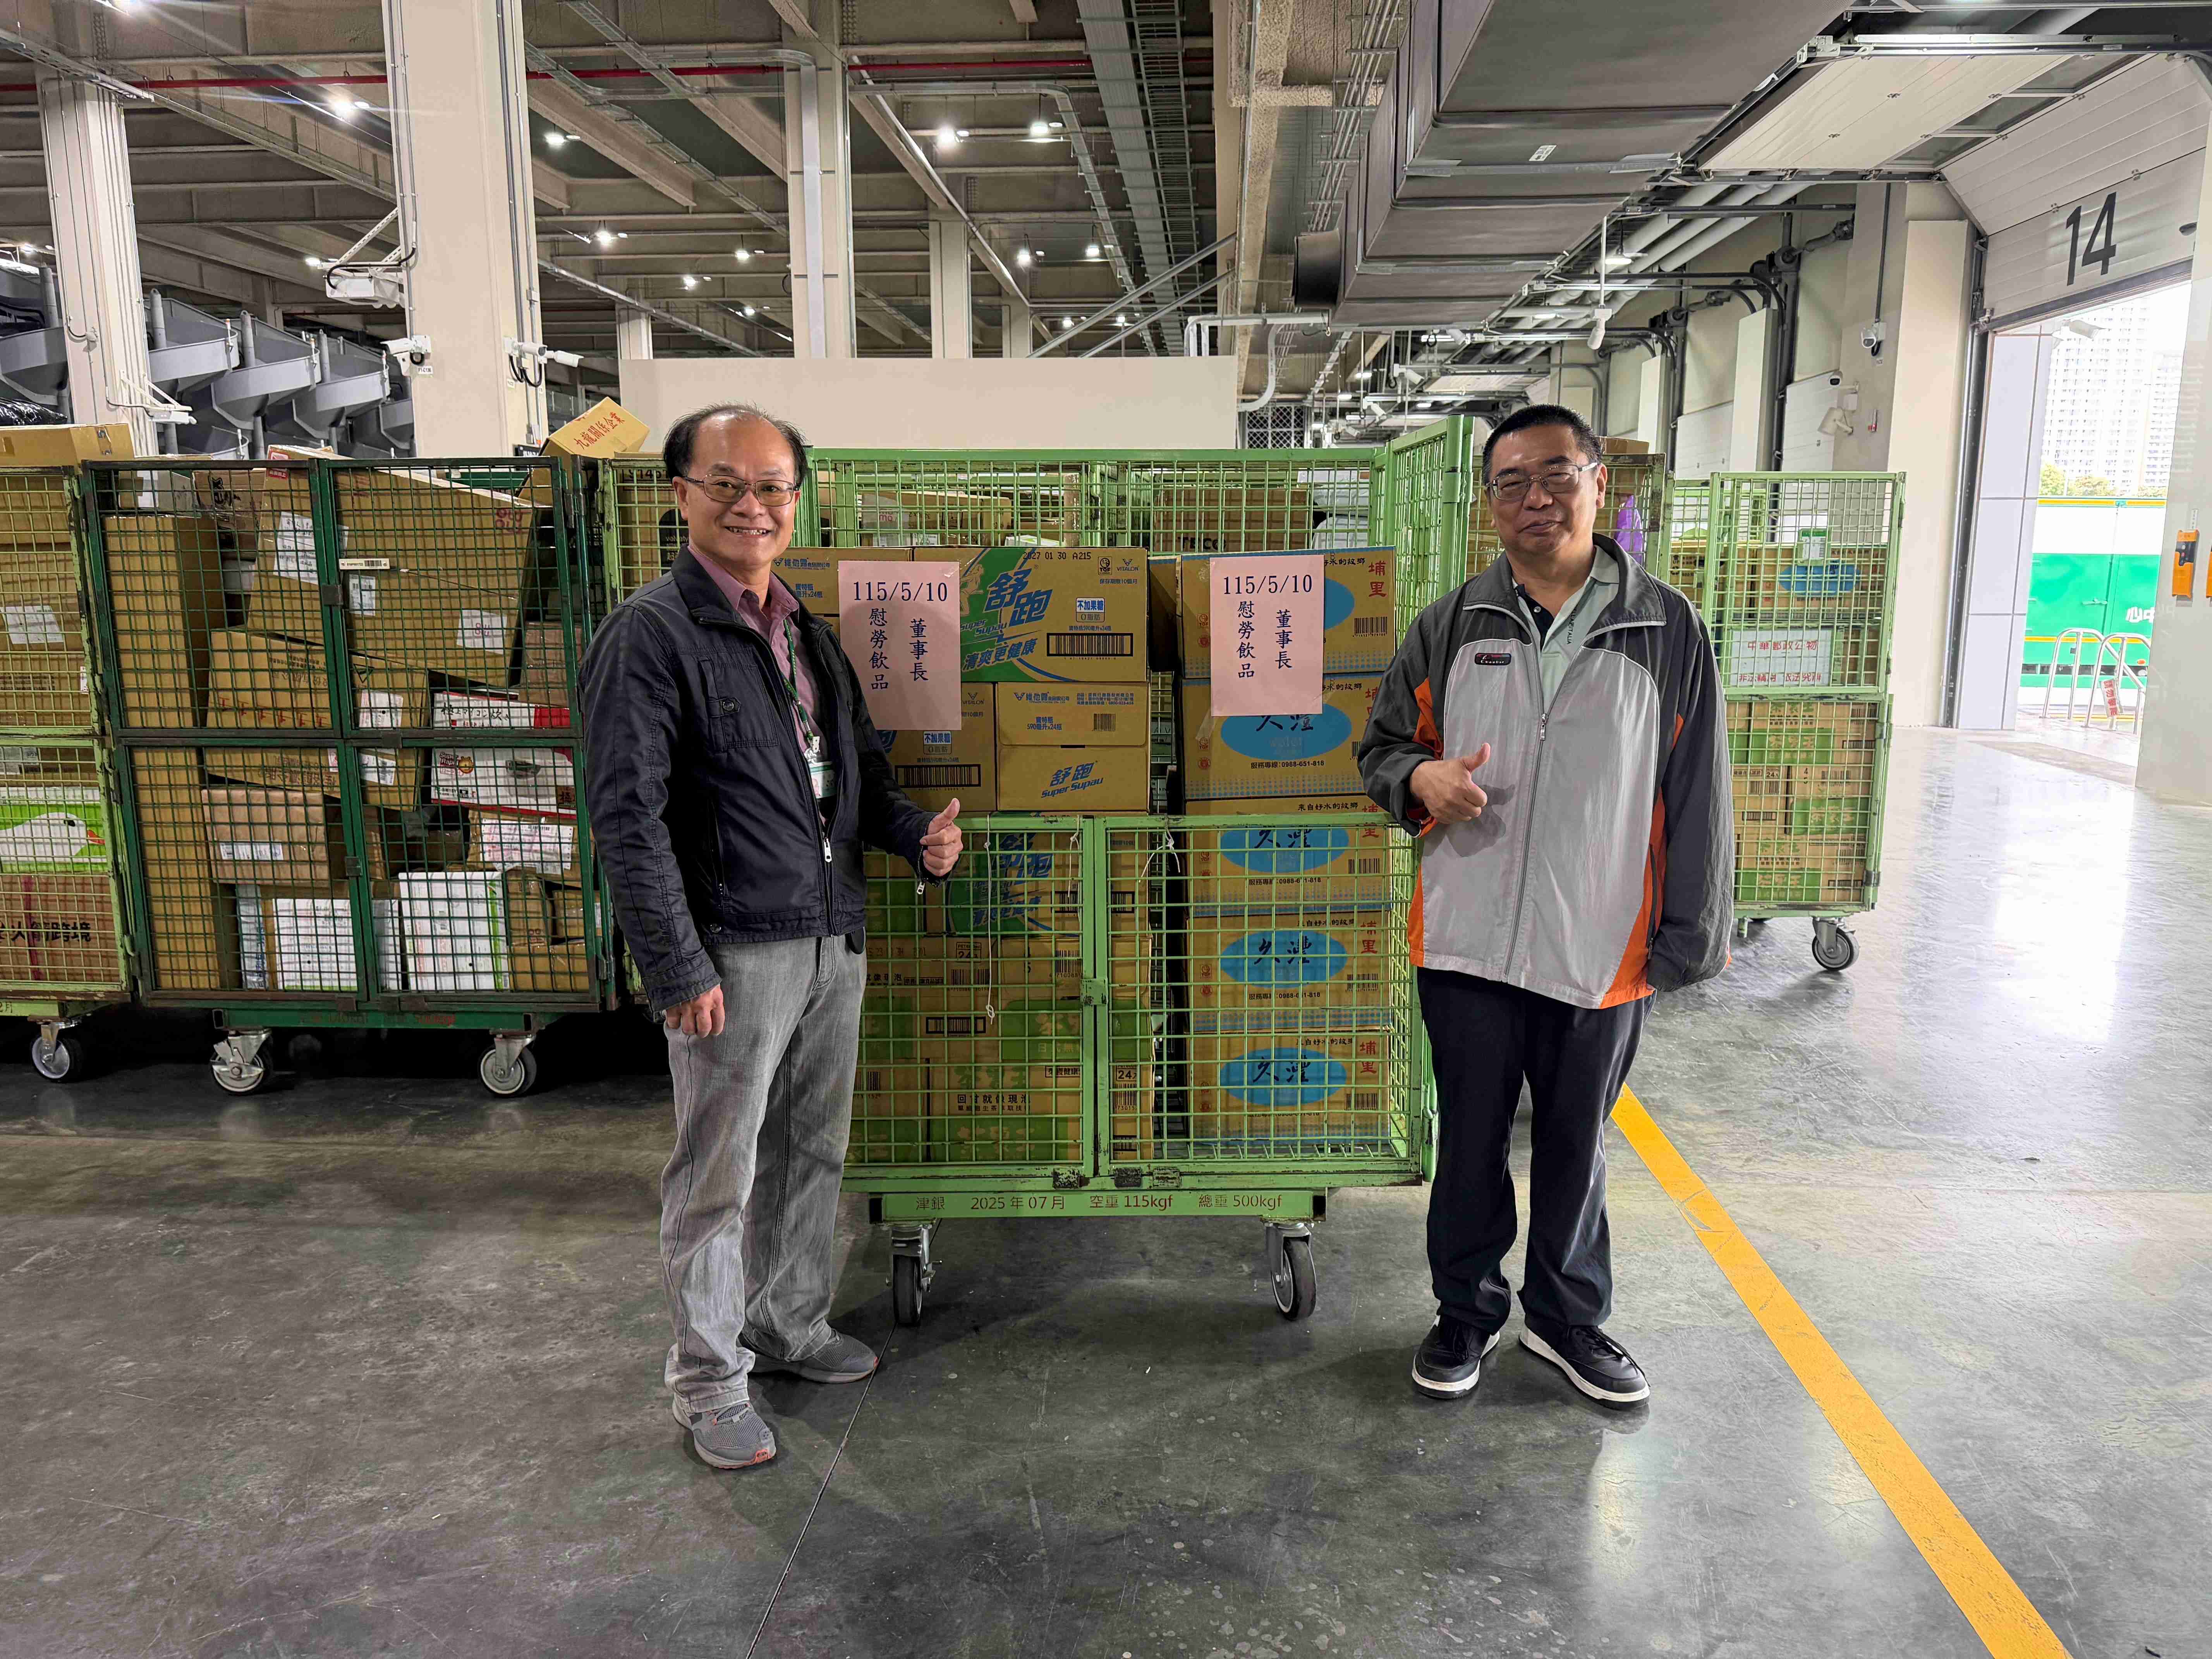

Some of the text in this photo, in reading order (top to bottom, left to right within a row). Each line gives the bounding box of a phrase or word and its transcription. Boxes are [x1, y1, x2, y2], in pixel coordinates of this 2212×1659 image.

[2066, 191, 2117, 286] 14
[853, 581, 948, 601] 115/5/10
[1223, 575, 1312, 594] 115/5/10
[1368, 560, 1387, 597] 埔里
[984, 568, 1053, 627] 舒跑
[1077, 600, 1104, 611] 不加果糖
[869, 608, 889, 690] 慰勞飲品
[909, 618, 929, 682] 董事長
[962, 638, 1037, 672] 清爽更健康
[1237, 601, 1256, 678] 慰勞飲品
[1274, 610, 1292, 670] 董事長
[924, 733, 951, 743] 不加果糖
[1041, 777, 1104, 799] Super Supau
[1050, 762, 1094, 787] 舒跑
[971, 1197, 1005, 1209] 2025
[1010, 1196, 1024, 1209] 年
[1029, 1197, 1046, 1209] 07
[1051, 1196, 1065, 1210] 月
[1090, 1195, 1119, 1209] 空重
[1124, 1195, 1173, 1211] 115kgf
[1199, 1195, 1228, 1208] 總重
[1233, 1195, 1283, 1211] 500kgf
